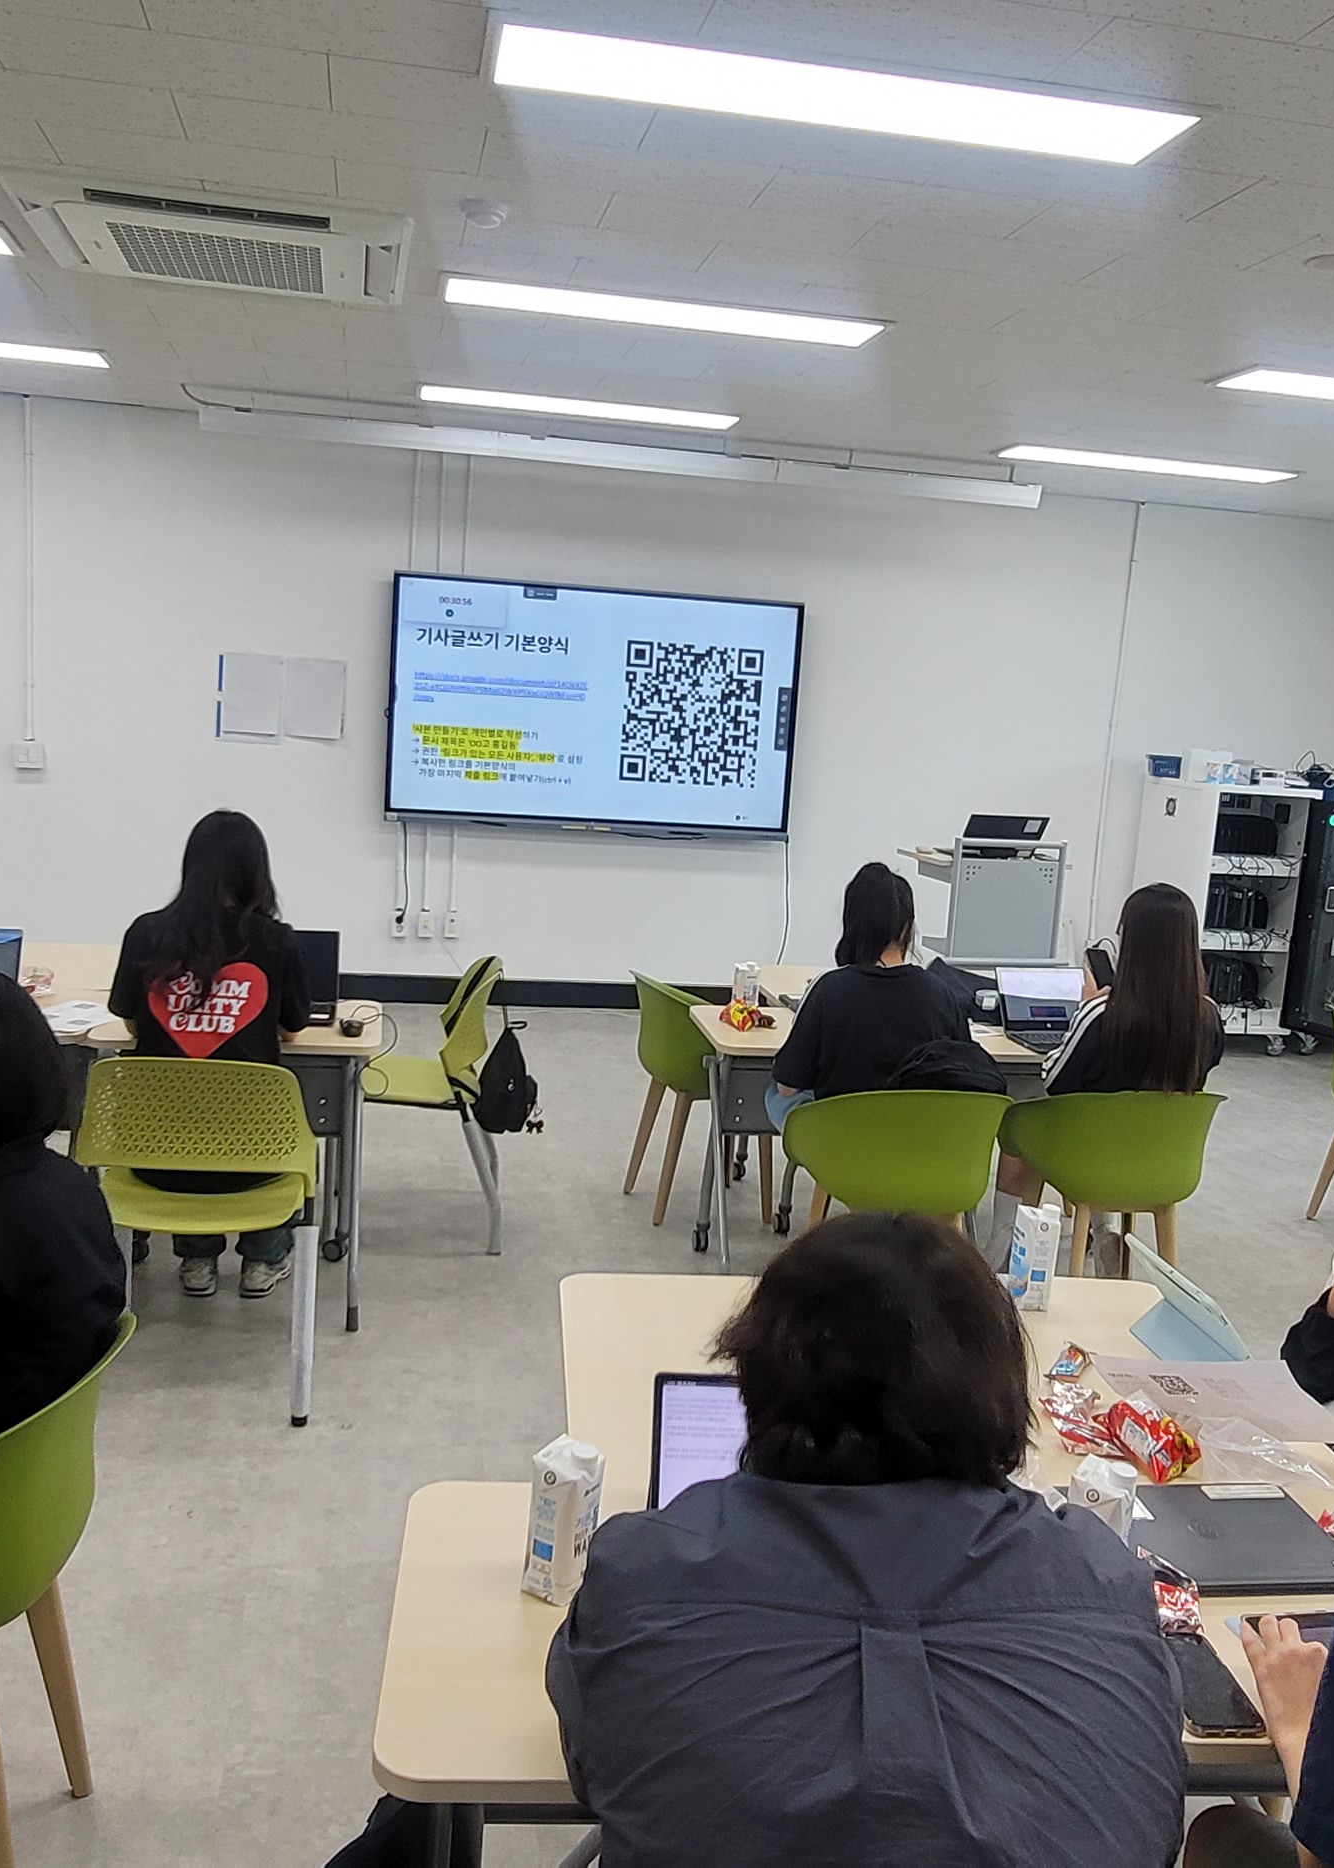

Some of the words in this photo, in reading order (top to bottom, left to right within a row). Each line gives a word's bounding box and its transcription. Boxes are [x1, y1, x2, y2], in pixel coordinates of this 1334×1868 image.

[416, 627, 499, 650] 기사글쓰기
[504, 633, 569, 655] 기본양식
[169, 1012, 236, 1033] CLUB
